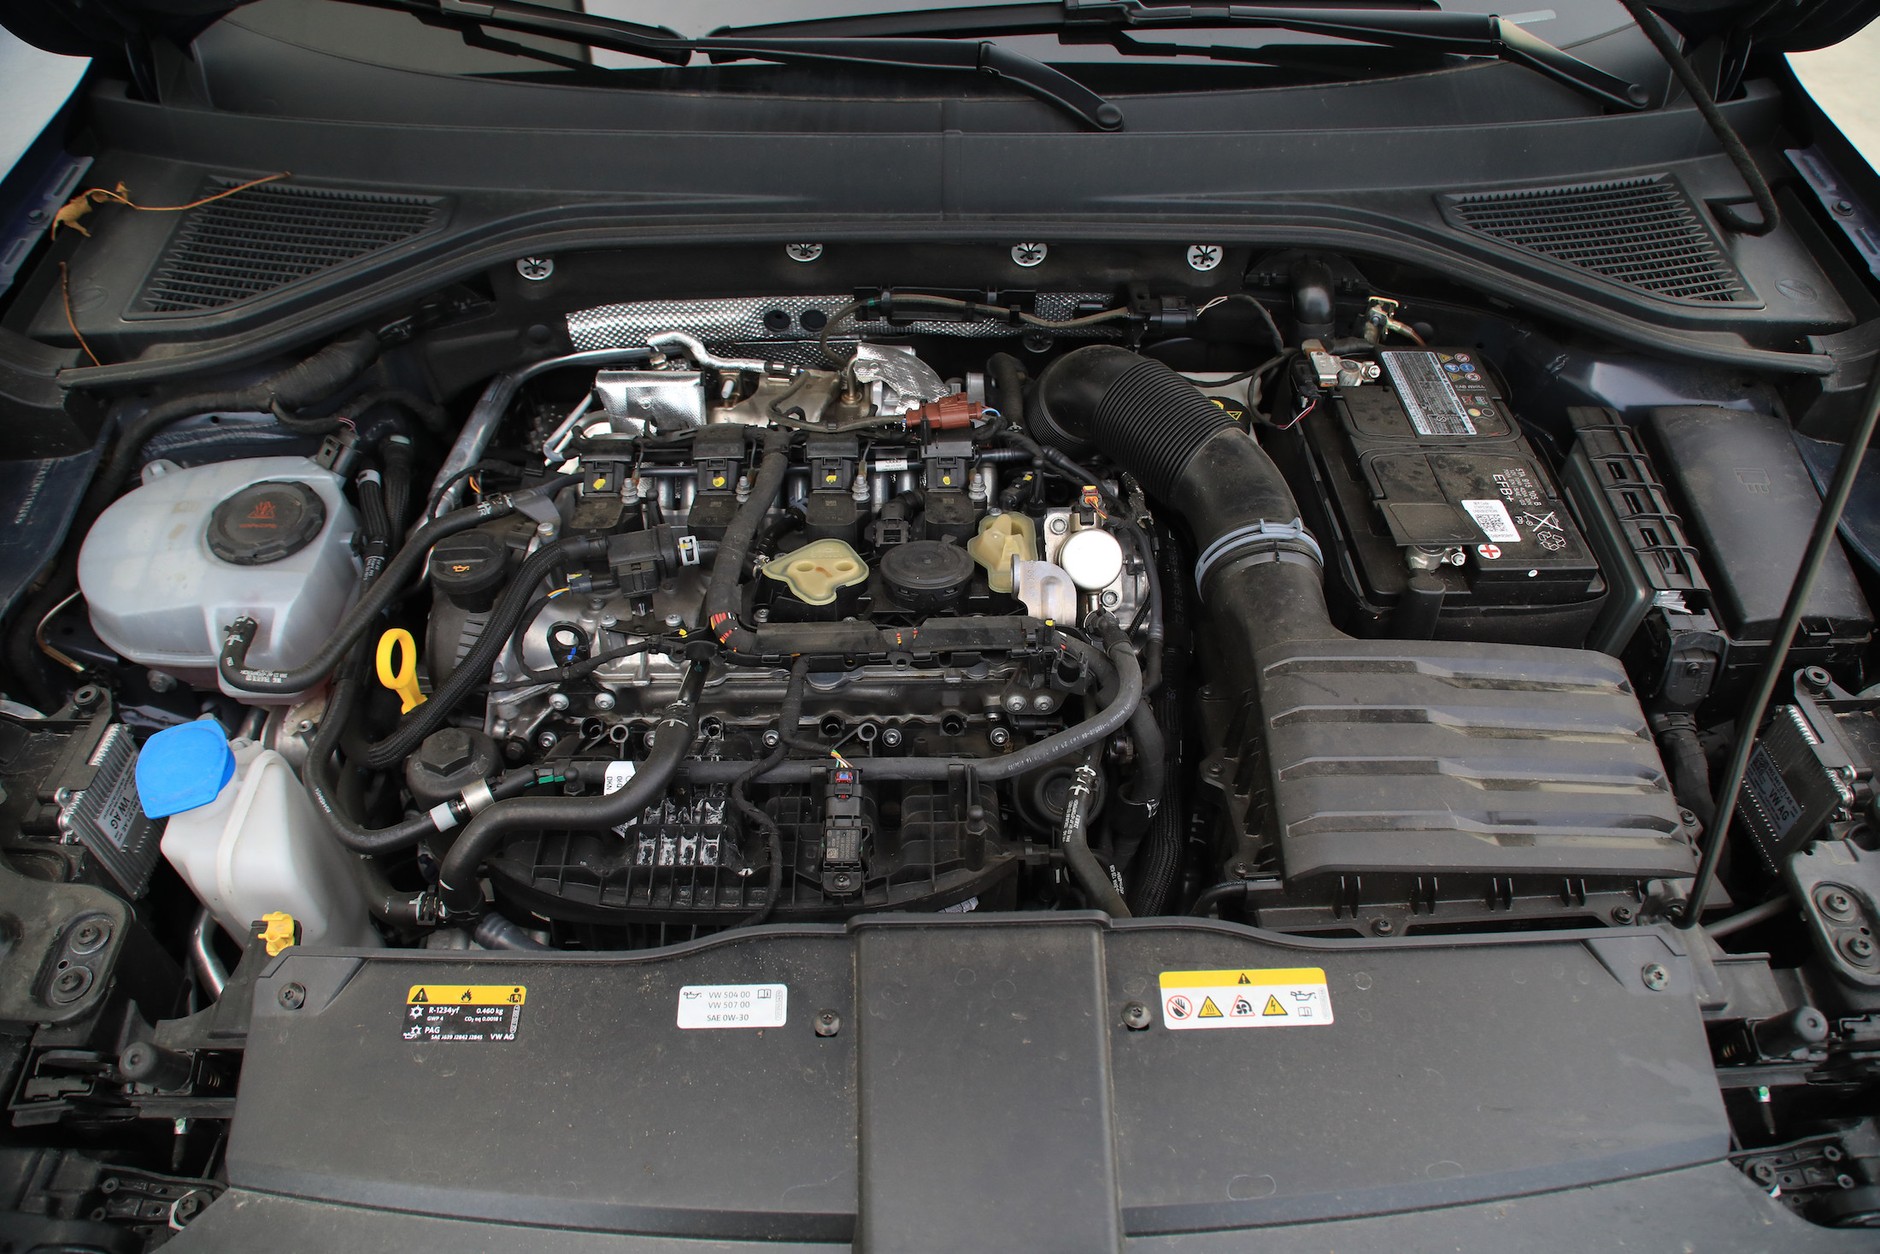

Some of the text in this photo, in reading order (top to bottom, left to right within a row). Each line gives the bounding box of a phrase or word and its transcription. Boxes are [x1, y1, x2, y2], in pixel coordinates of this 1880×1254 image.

[1493, 474, 1514, 502] EFB+
[111, 812, 121, 829] AG
[1777, 805, 1789, 821] AG
[428, 1006, 460, 1015] R-1234yf
